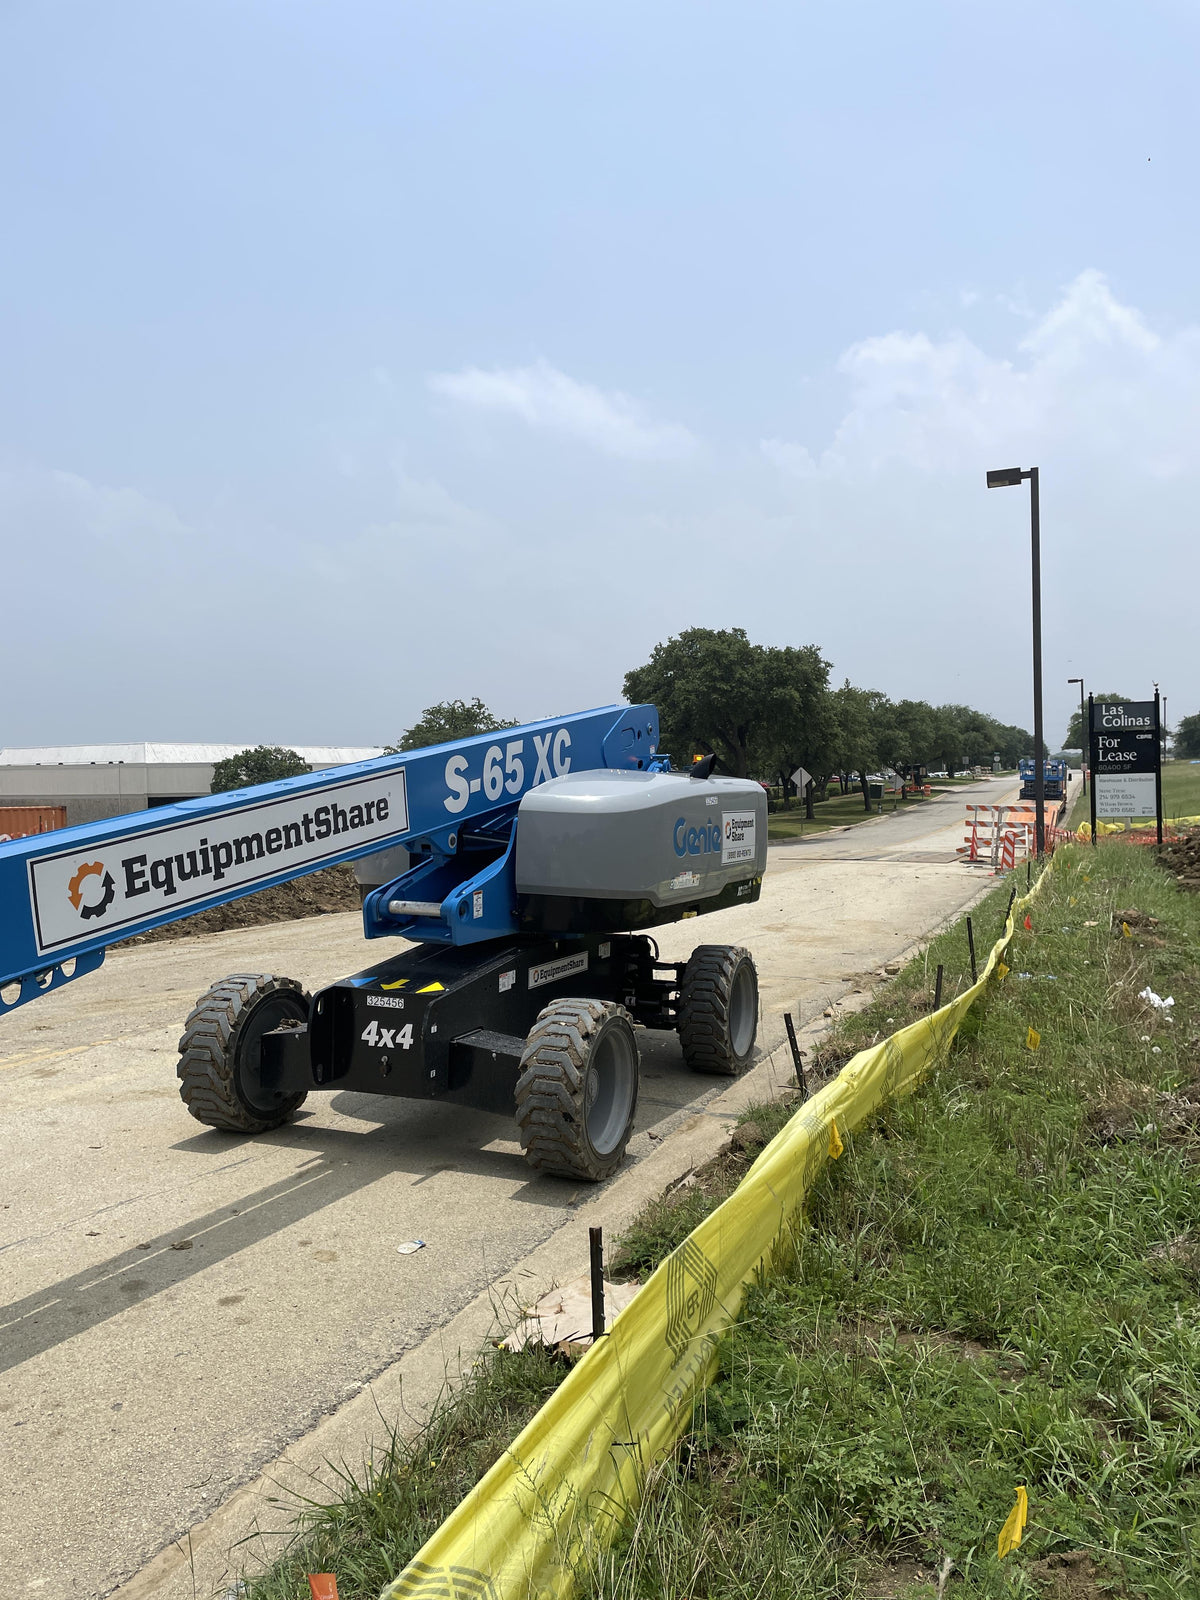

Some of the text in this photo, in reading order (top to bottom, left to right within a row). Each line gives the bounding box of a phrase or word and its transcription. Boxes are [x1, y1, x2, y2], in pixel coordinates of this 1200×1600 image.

[1102, 704, 1124, 716] Las
[1102, 714, 1151, 727] Colinas
[1098, 736, 1121, 749] For
[1098, 749, 1137, 762] Lease
[443, 728, 572, 814] S-65 XC
[731, 818, 755, 832] Equipment
[673, 815, 721, 859] Genie
[731, 831, 745, 842] Share
[121, 797, 390, 899] EquipmentShare
[539, 959, 585, 981] EquipmentShare
[367, 995, 404, 1009] 325456
[360, 1020, 414, 1050] 4x4
